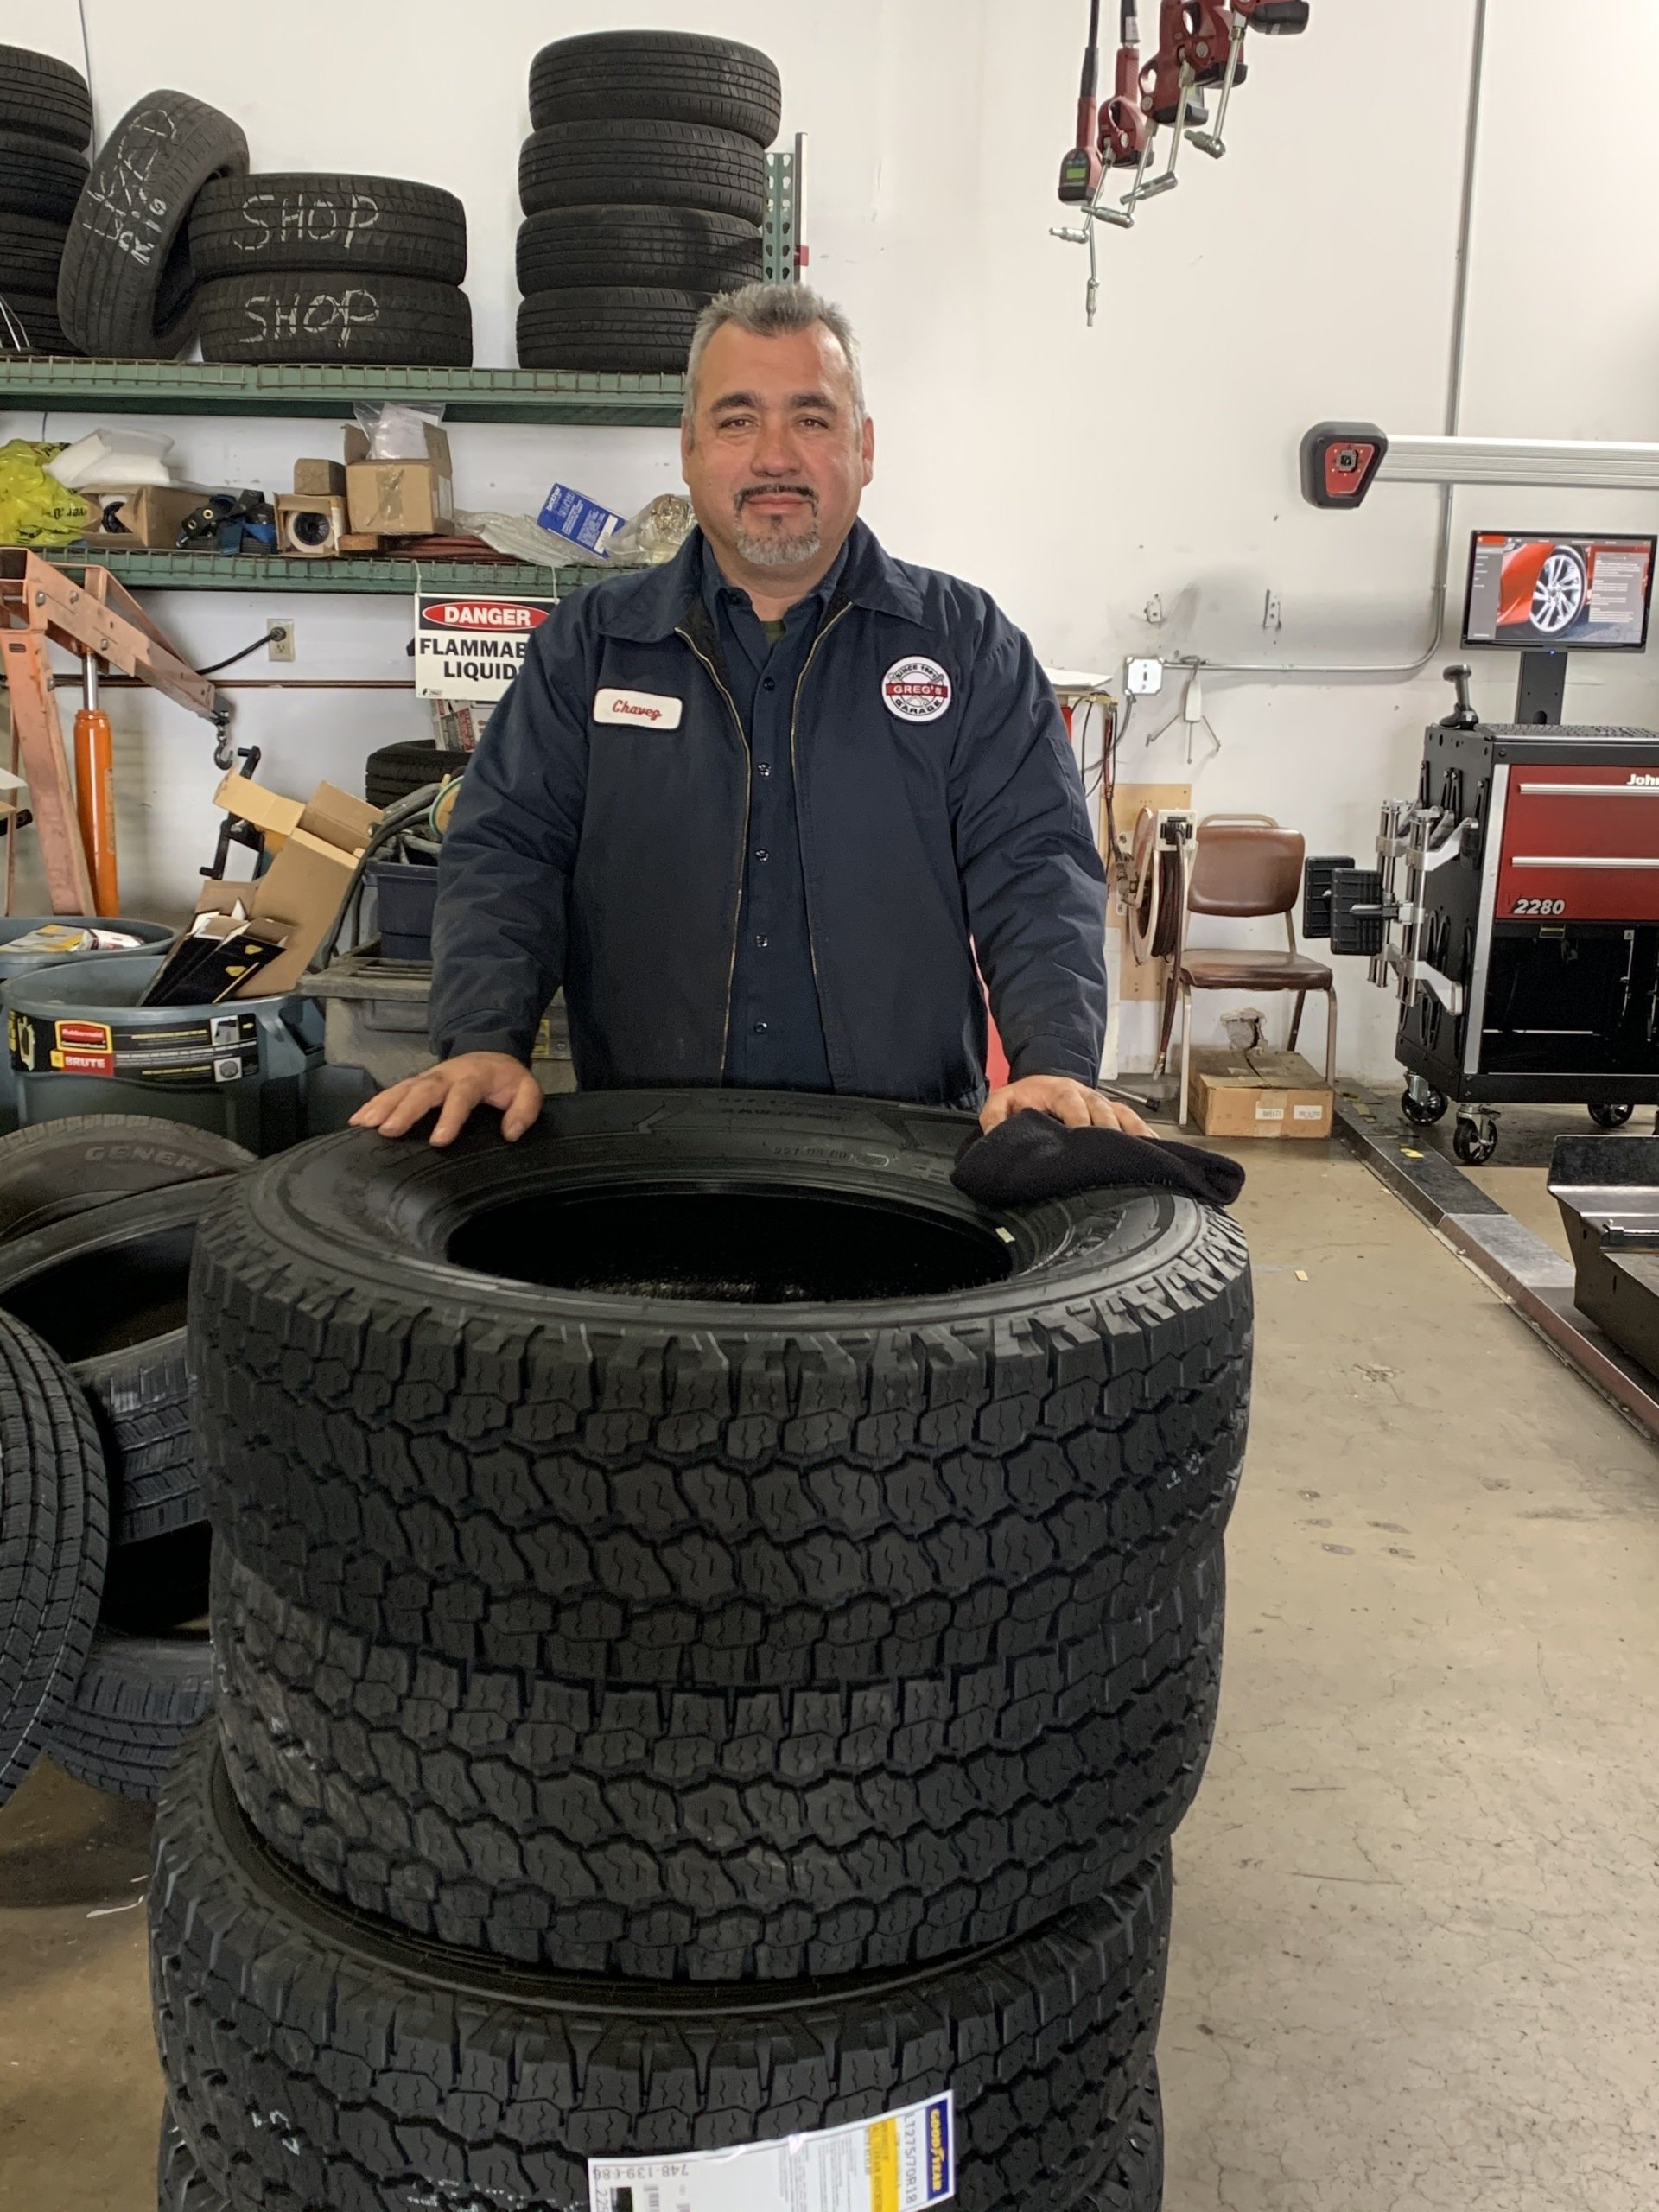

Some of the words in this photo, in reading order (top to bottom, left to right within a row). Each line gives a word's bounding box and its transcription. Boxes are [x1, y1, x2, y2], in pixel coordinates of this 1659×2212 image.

[233, 194, 379, 251] SHOP
[239, 289, 380, 348] SHOP
[444, 607, 531, 626] DANGER
[443, 661, 524, 681] LIQUID
[895, 664, 918, 677] SINCE
[893, 685, 942, 695] GREG'S
[895, 699, 941, 714] GARAGE
[65, 1056, 105, 1068] BRUTE
[931, 2108, 944, 2191] GOODYEAR
